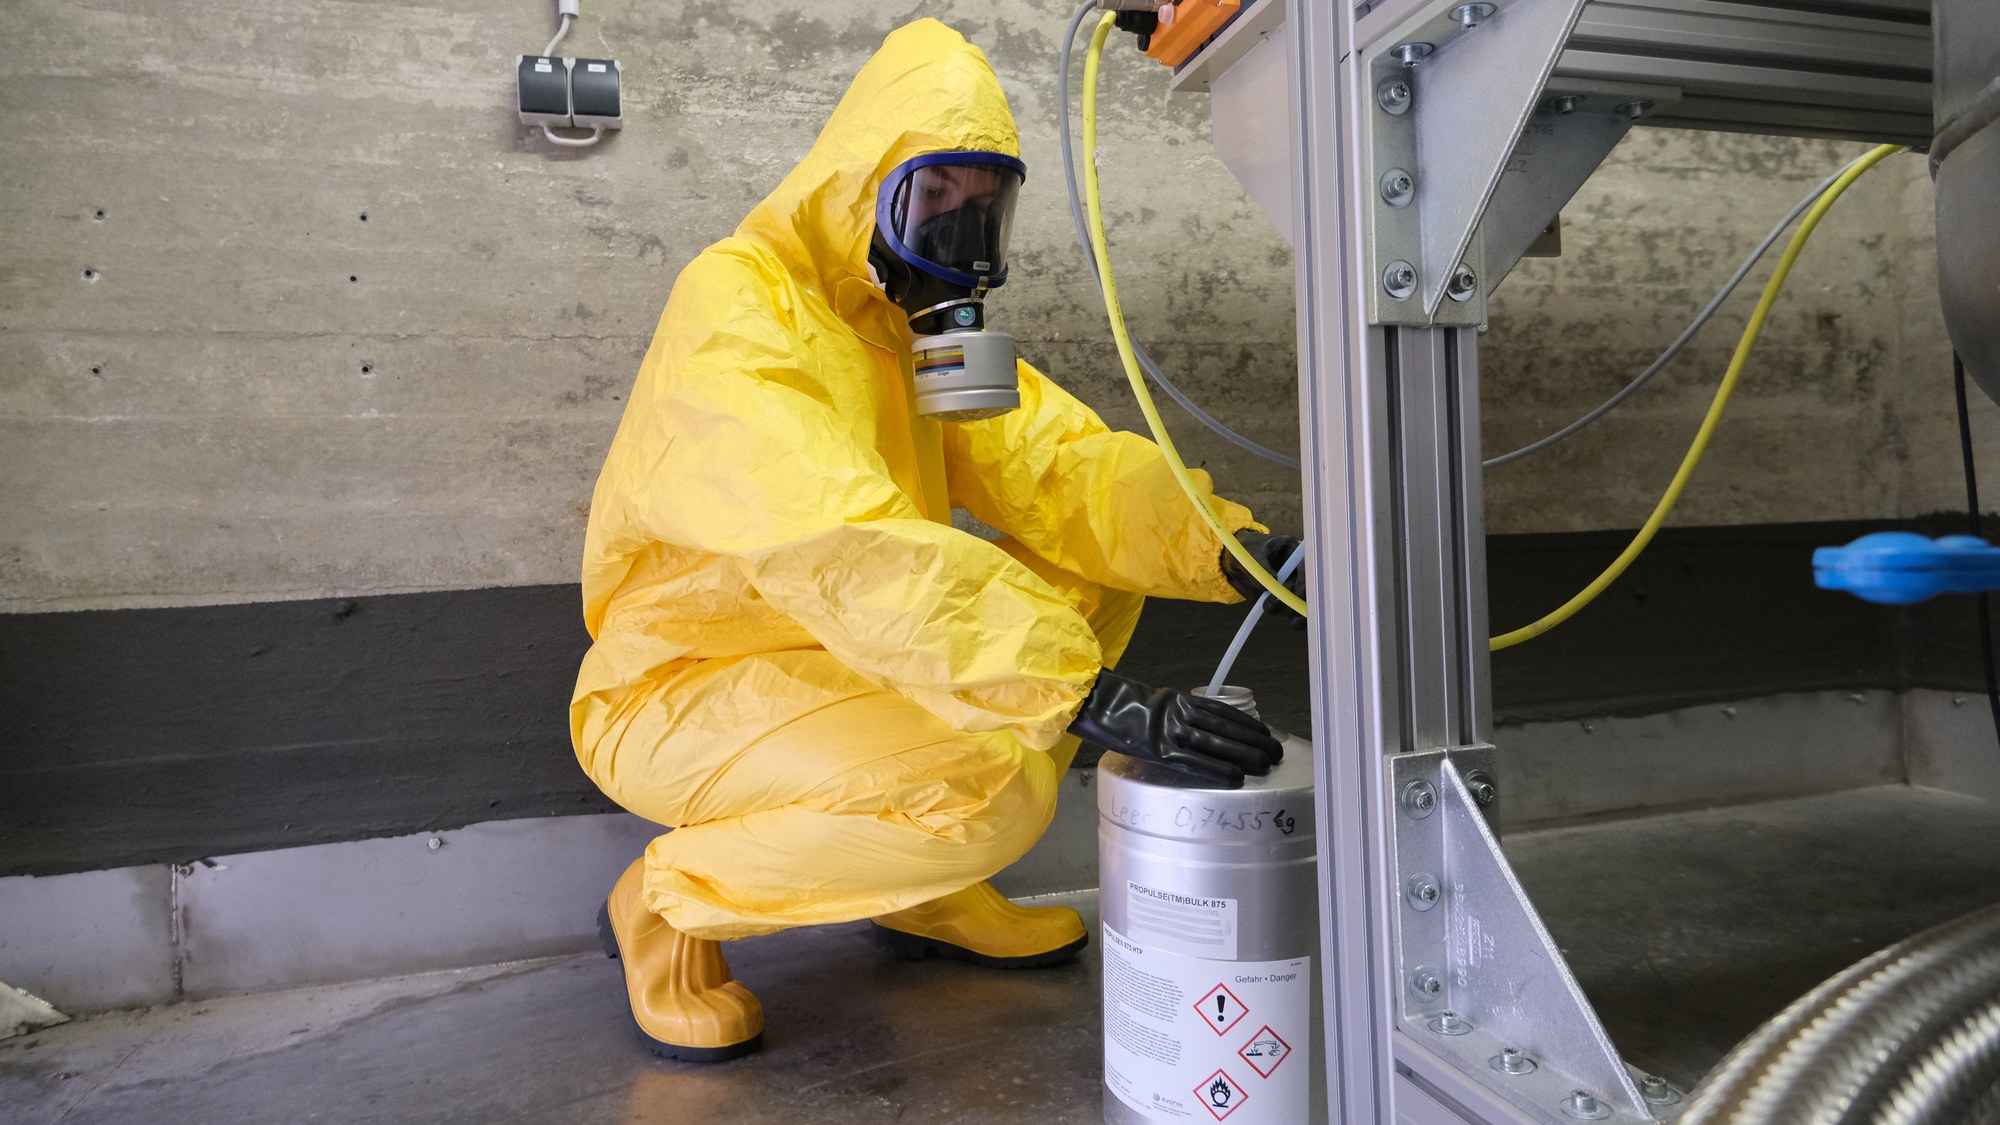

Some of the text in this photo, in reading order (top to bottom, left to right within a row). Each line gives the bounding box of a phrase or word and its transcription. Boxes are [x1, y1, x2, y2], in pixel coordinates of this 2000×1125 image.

[1130, 882, 1226, 908] PROPULSE(TM)BULK 875
[1235, 973, 1296, 983] Gefahr Danger
